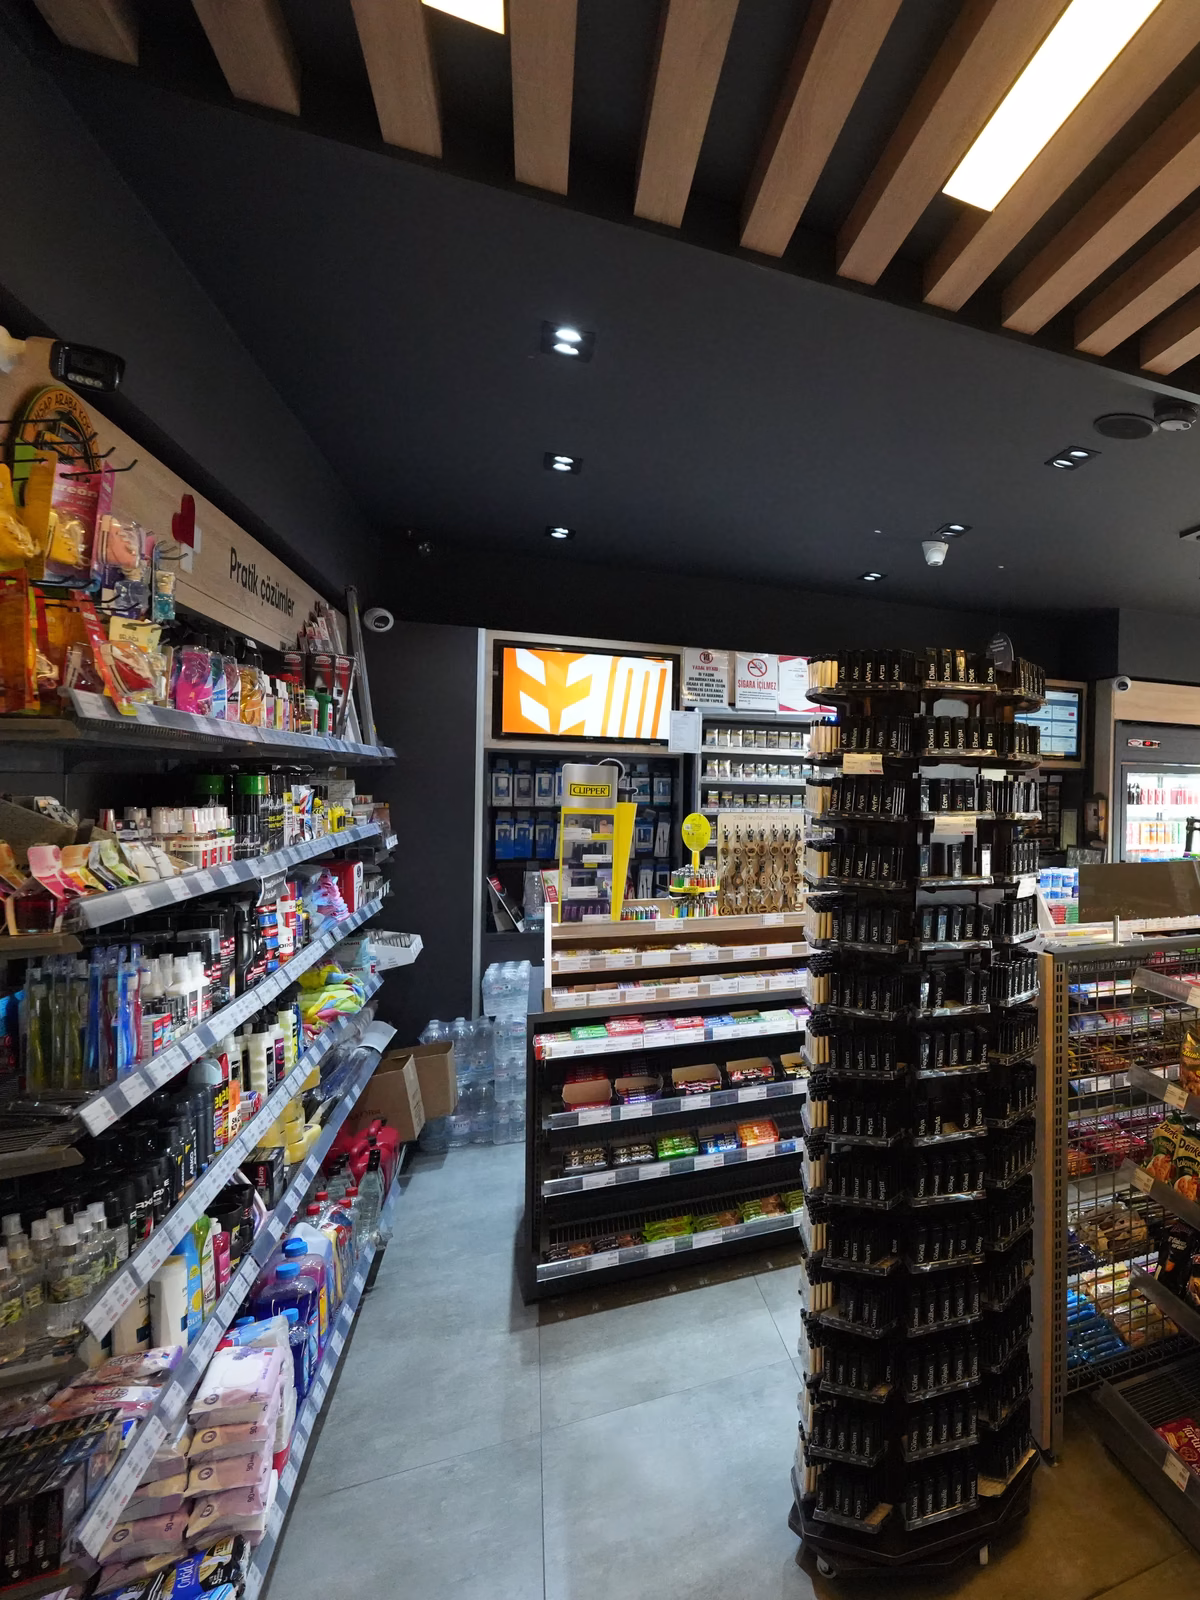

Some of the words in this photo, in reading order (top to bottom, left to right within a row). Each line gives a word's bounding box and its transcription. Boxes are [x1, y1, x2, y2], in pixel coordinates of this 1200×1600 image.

[230, 546, 258, 596] Pratik
[260, 575, 295, 618] çözümler
[738, 677, 756, 689] SİGARA
[757, 679, 777, 692] İÇİLMEZ
[177, 1558, 195, 1589] Orkid
